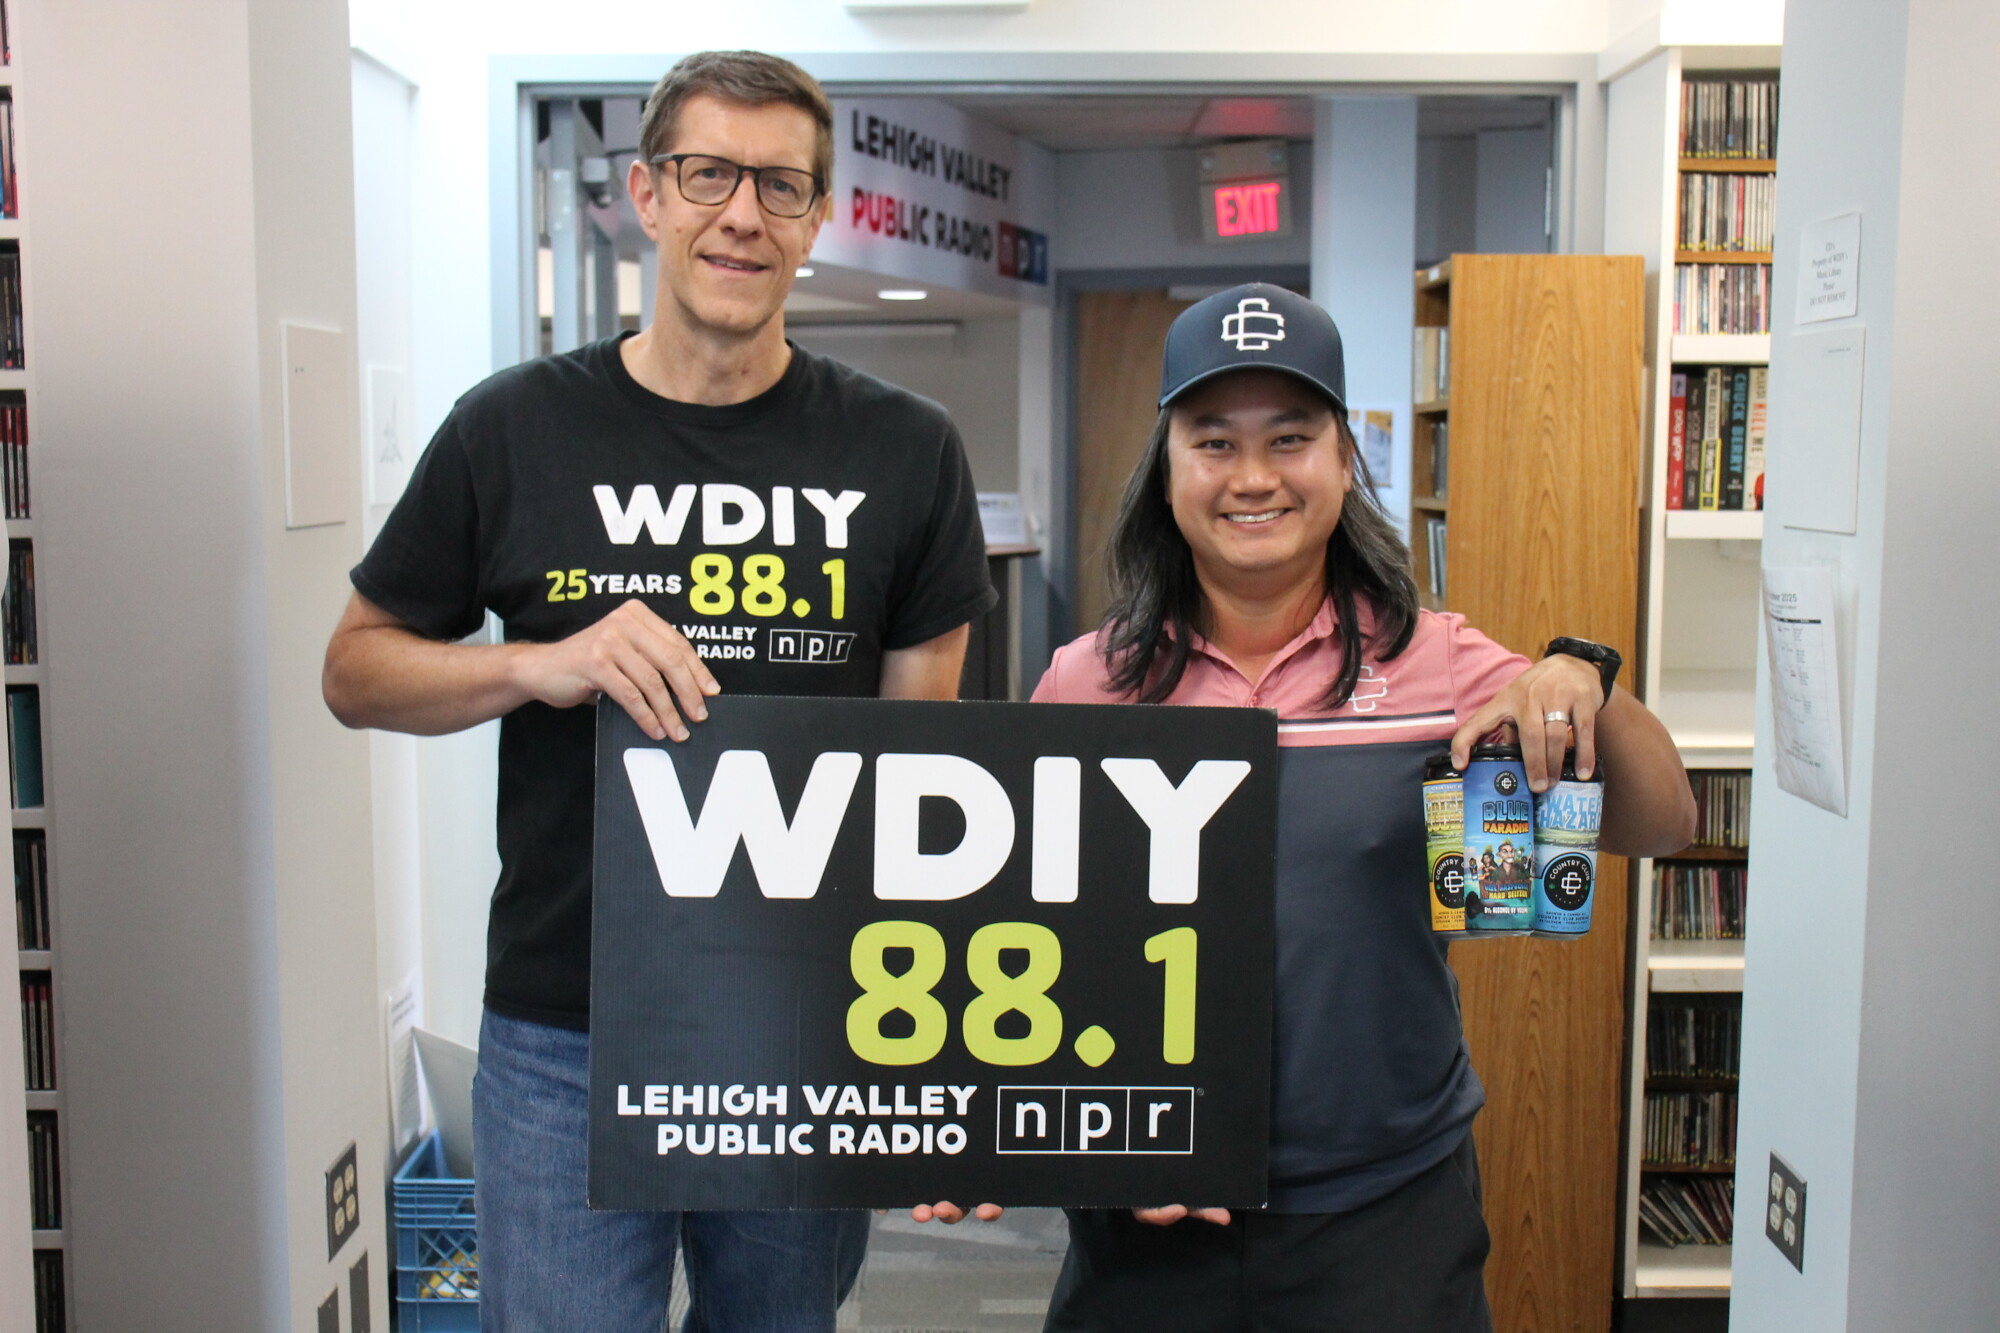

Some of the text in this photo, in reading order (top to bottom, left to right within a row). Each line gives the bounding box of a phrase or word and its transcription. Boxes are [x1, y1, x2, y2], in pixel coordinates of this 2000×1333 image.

[851, 109, 1012, 201] LEHIGH VALLEY
[851, 187, 930, 246] PUBLIC
[935, 212, 993, 263] RADIO
[1214, 182, 1281, 237] EXIT
[1731, 373, 1747, 421] CHUCK
[1729, 425, 1745, 473] BERRY
[593, 483, 867, 549] WDIY
[689, 553, 845, 620] 88.1
[682, 624, 758, 641] VALLEY
[696, 644, 756, 660] RADIO
[778, 635, 846, 661] npr
[622, 747, 1252, 904] WDIY
[1482, 800, 1529, 821] BLUE
[1483, 822, 1530, 835] PARADISE
[1435, 858, 1459, 881] COUNTRY
[1549, 859, 1590, 881] COUNTRY CLUB
[845, 919, 1199, 1068] 88.1
[616, 1083, 978, 1117] LEHIGH VALLEY
[656, 1122, 968, 1156] PUBLIC RADIO
[1014, 1099, 1173, 1151] npr
